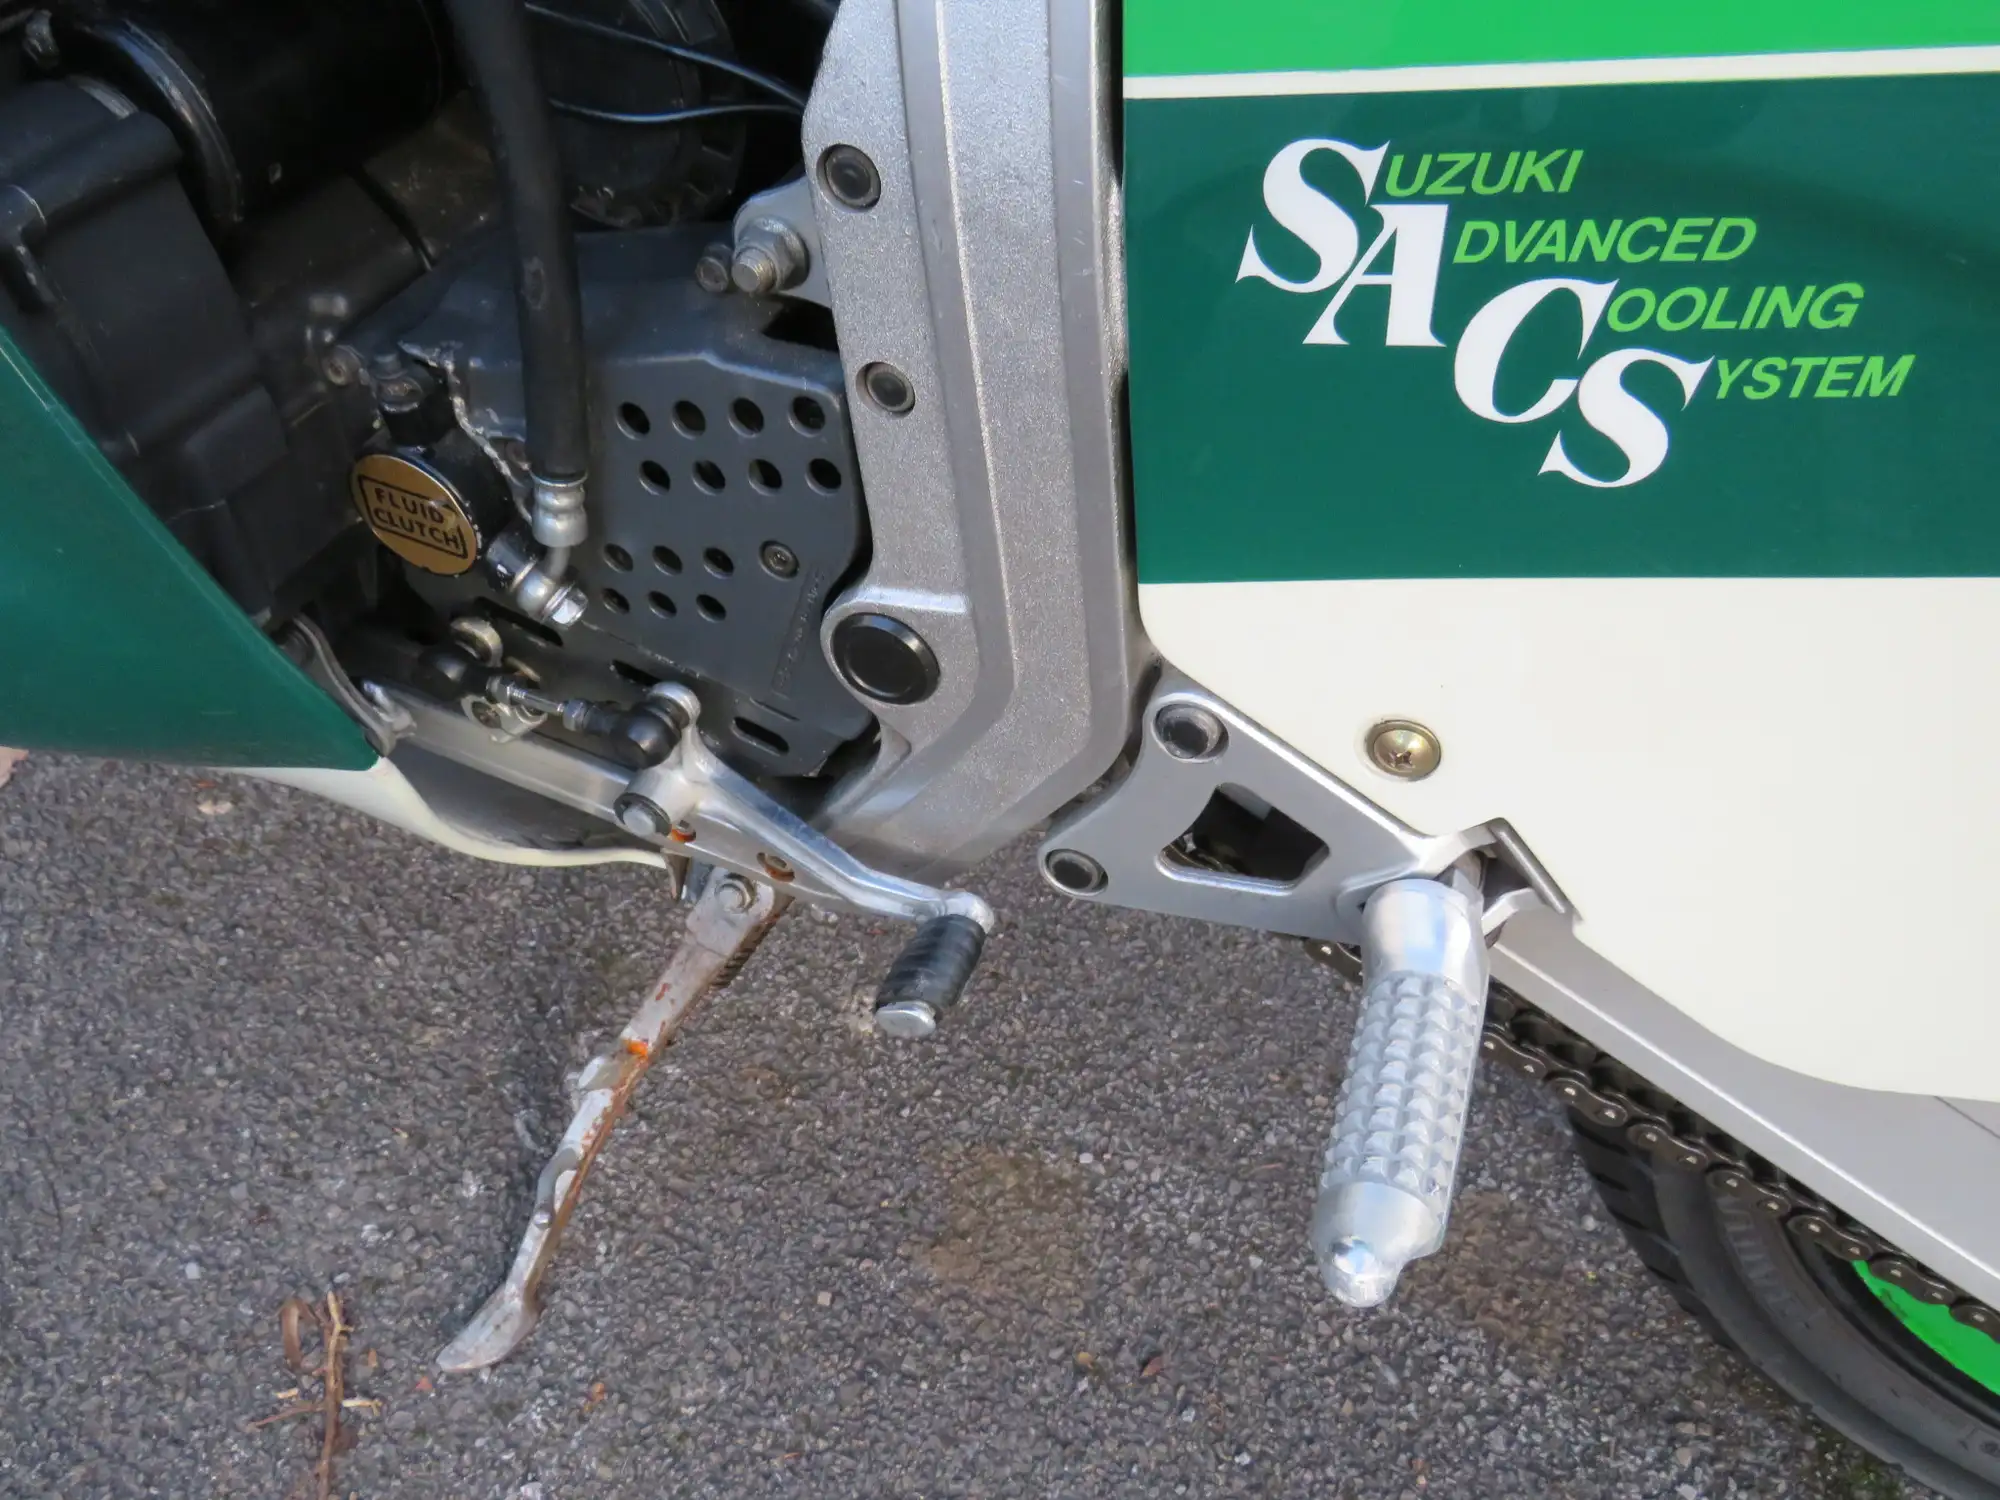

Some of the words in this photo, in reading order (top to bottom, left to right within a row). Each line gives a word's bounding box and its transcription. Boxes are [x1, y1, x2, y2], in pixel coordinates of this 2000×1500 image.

[1235, 138, 1584, 293] SUZUKI
[1302, 204, 1757, 347] ADVANCED
[1454, 278, 1865, 424] COOLING
[1537, 347, 1916, 488] SYSTEM
[373, 507, 460, 550] CLUTCH
[374, 487, 445, 524] FLUID
